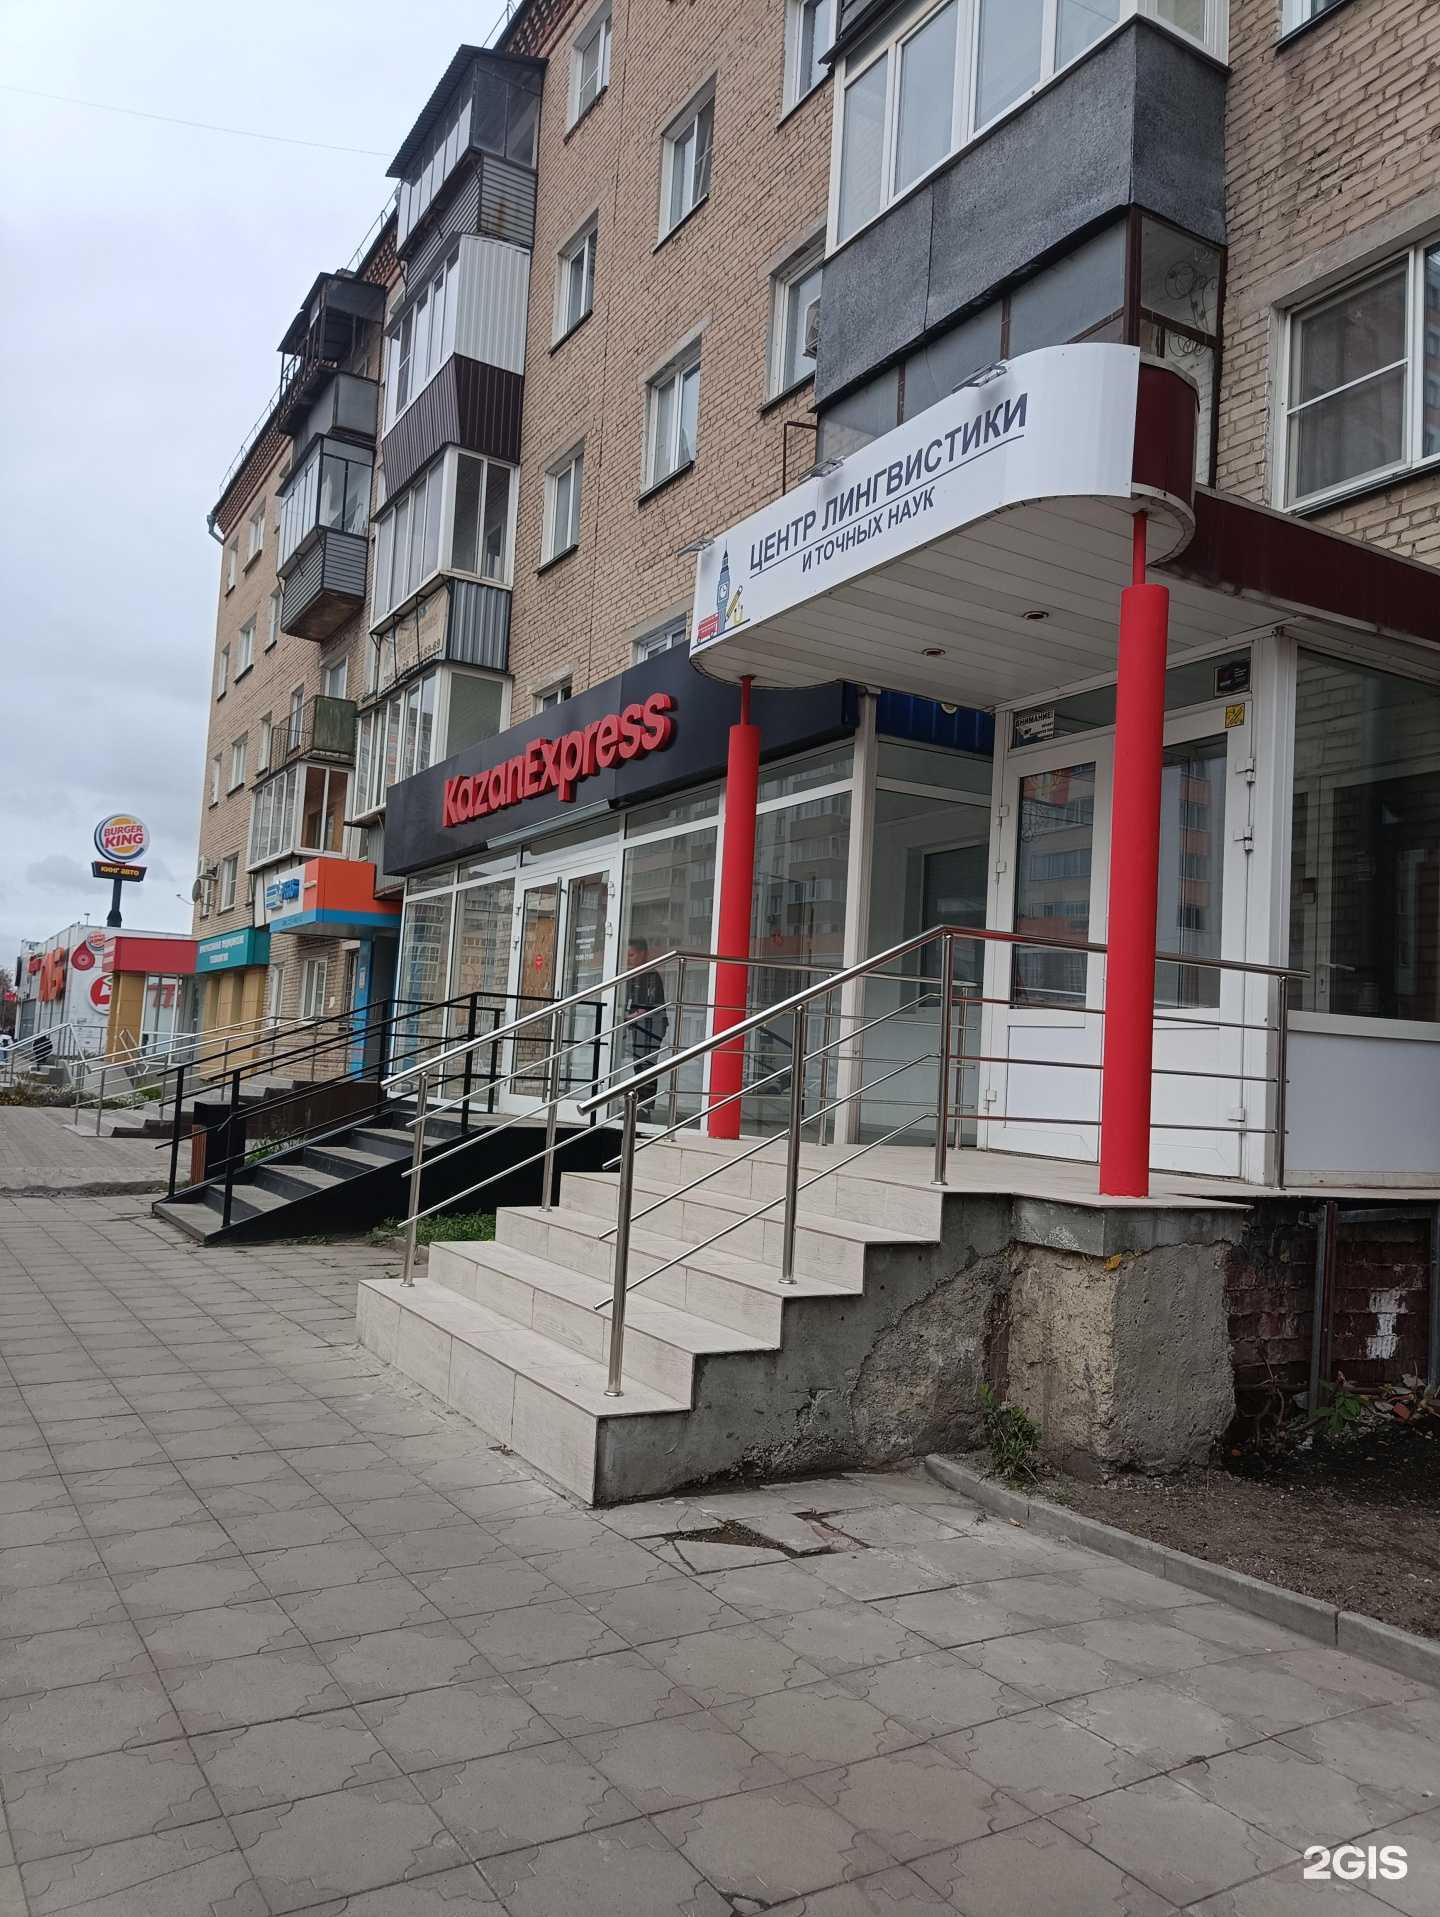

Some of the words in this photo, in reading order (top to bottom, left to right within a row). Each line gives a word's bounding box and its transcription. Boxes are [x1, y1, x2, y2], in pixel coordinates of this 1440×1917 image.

[750, 510, 816, 571] ЦЕНТР
[821, 392, 1029, 531] ЛИНГВИСТИКИ
[802, 551, 812, 573] И
[815, 512, 883, 565] ТОЧНЫХ
[888, 486, 935, 529] НАУК
[442, 692, 672, 828] KazanExpress
[104, 825, 143, 837] BURGER
[104, 833, 144, 849] KING
